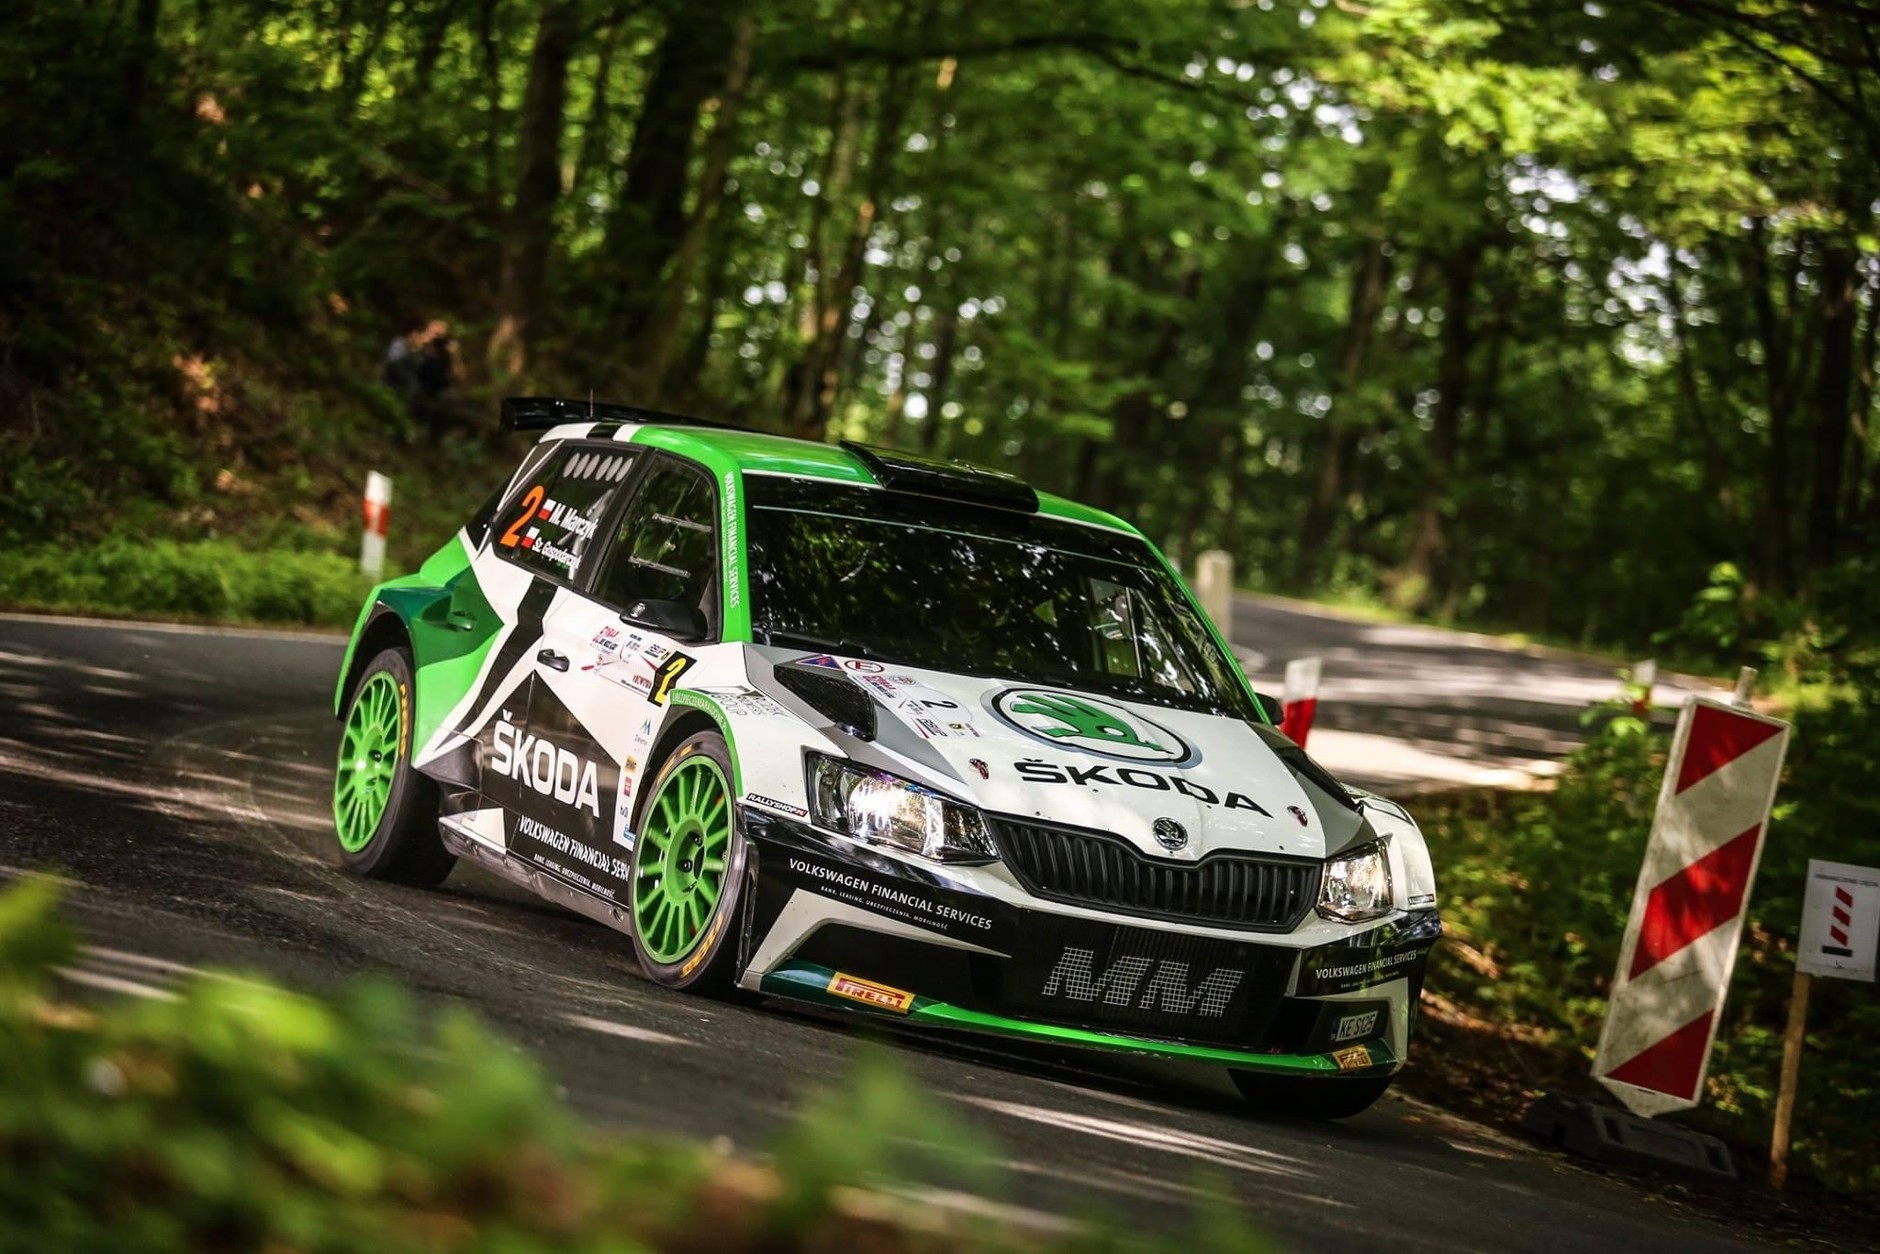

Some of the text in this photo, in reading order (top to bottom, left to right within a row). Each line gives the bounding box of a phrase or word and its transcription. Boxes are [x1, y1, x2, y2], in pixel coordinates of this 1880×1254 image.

[500, 485, 545, 548] 2
[725, 471, 737, 521] VOLKSWAGEN
[548, 502, 599, 542] M. Marczyk
[727, 521, 738, 566] FINANCIAL
[729, 566, 740, 608] SERVICES
[654, 657, 688, 704] 2
[920, 699, 959, 710] 2
[491, 708, 600, 819] ŠKODA
[1013, 757, 1275, 819] ŠKODA
[519, 814, 572, 854] VOLKSWAGEN
[569, 838, 611, 873] FINANCIAL
[788, 857, 993, 931] VOLKSWAGEN FINANCIAL SERVICES
[1041, 947, 1247, 1018] MM
[1315, 949, 1417, 979] VOLKSWAGEN FINANCIAL SERVICES
[834, 977, 907, 1008] PIRELLI
